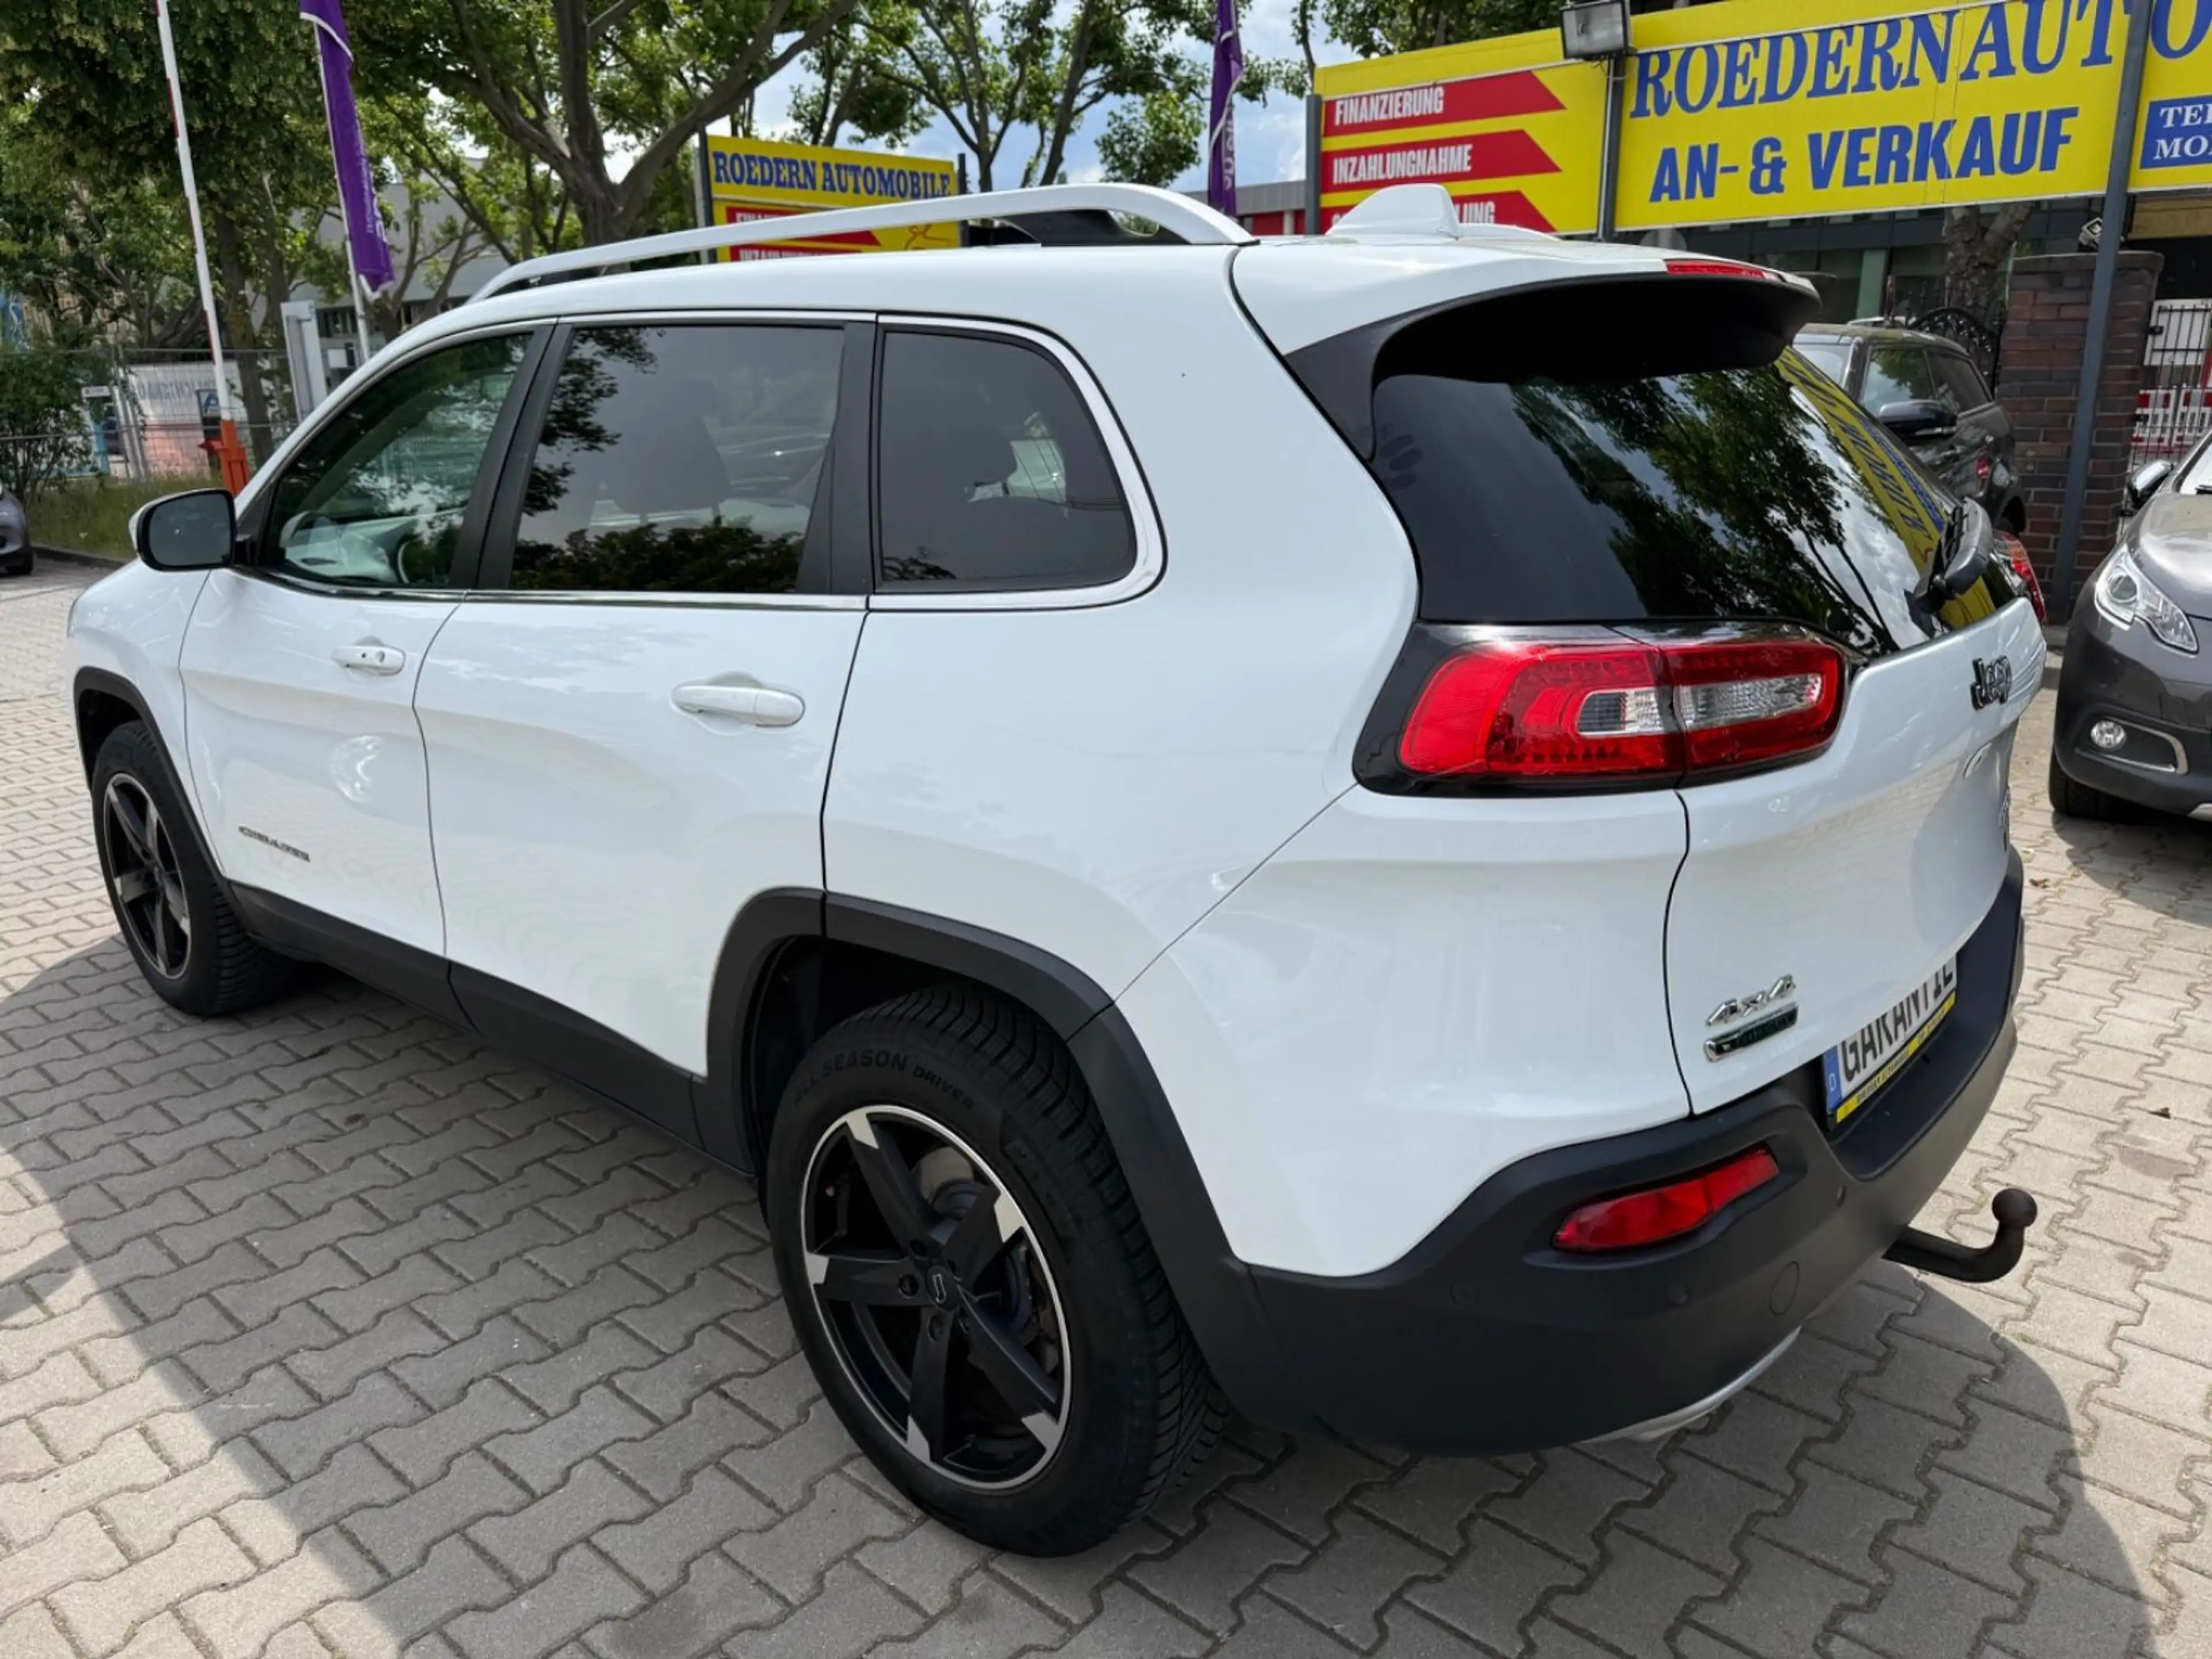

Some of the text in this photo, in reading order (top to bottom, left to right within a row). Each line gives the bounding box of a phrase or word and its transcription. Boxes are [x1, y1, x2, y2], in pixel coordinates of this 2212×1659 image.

[1334, 86, 1445, 126] FINANZIERUNG
[1332, 144, 1473, 185] INZAHLUNGNAHME
[1649, 107, 2080, 203] AN- & VERKAUF
[2153, 134, 2212, 160] MO
[712, 151, 952, 199] ROEDERN AUTOMOBILE
[822, 1048, 909, 1077] SEASON
[912, 1065, 975, 1110] DRIVER
